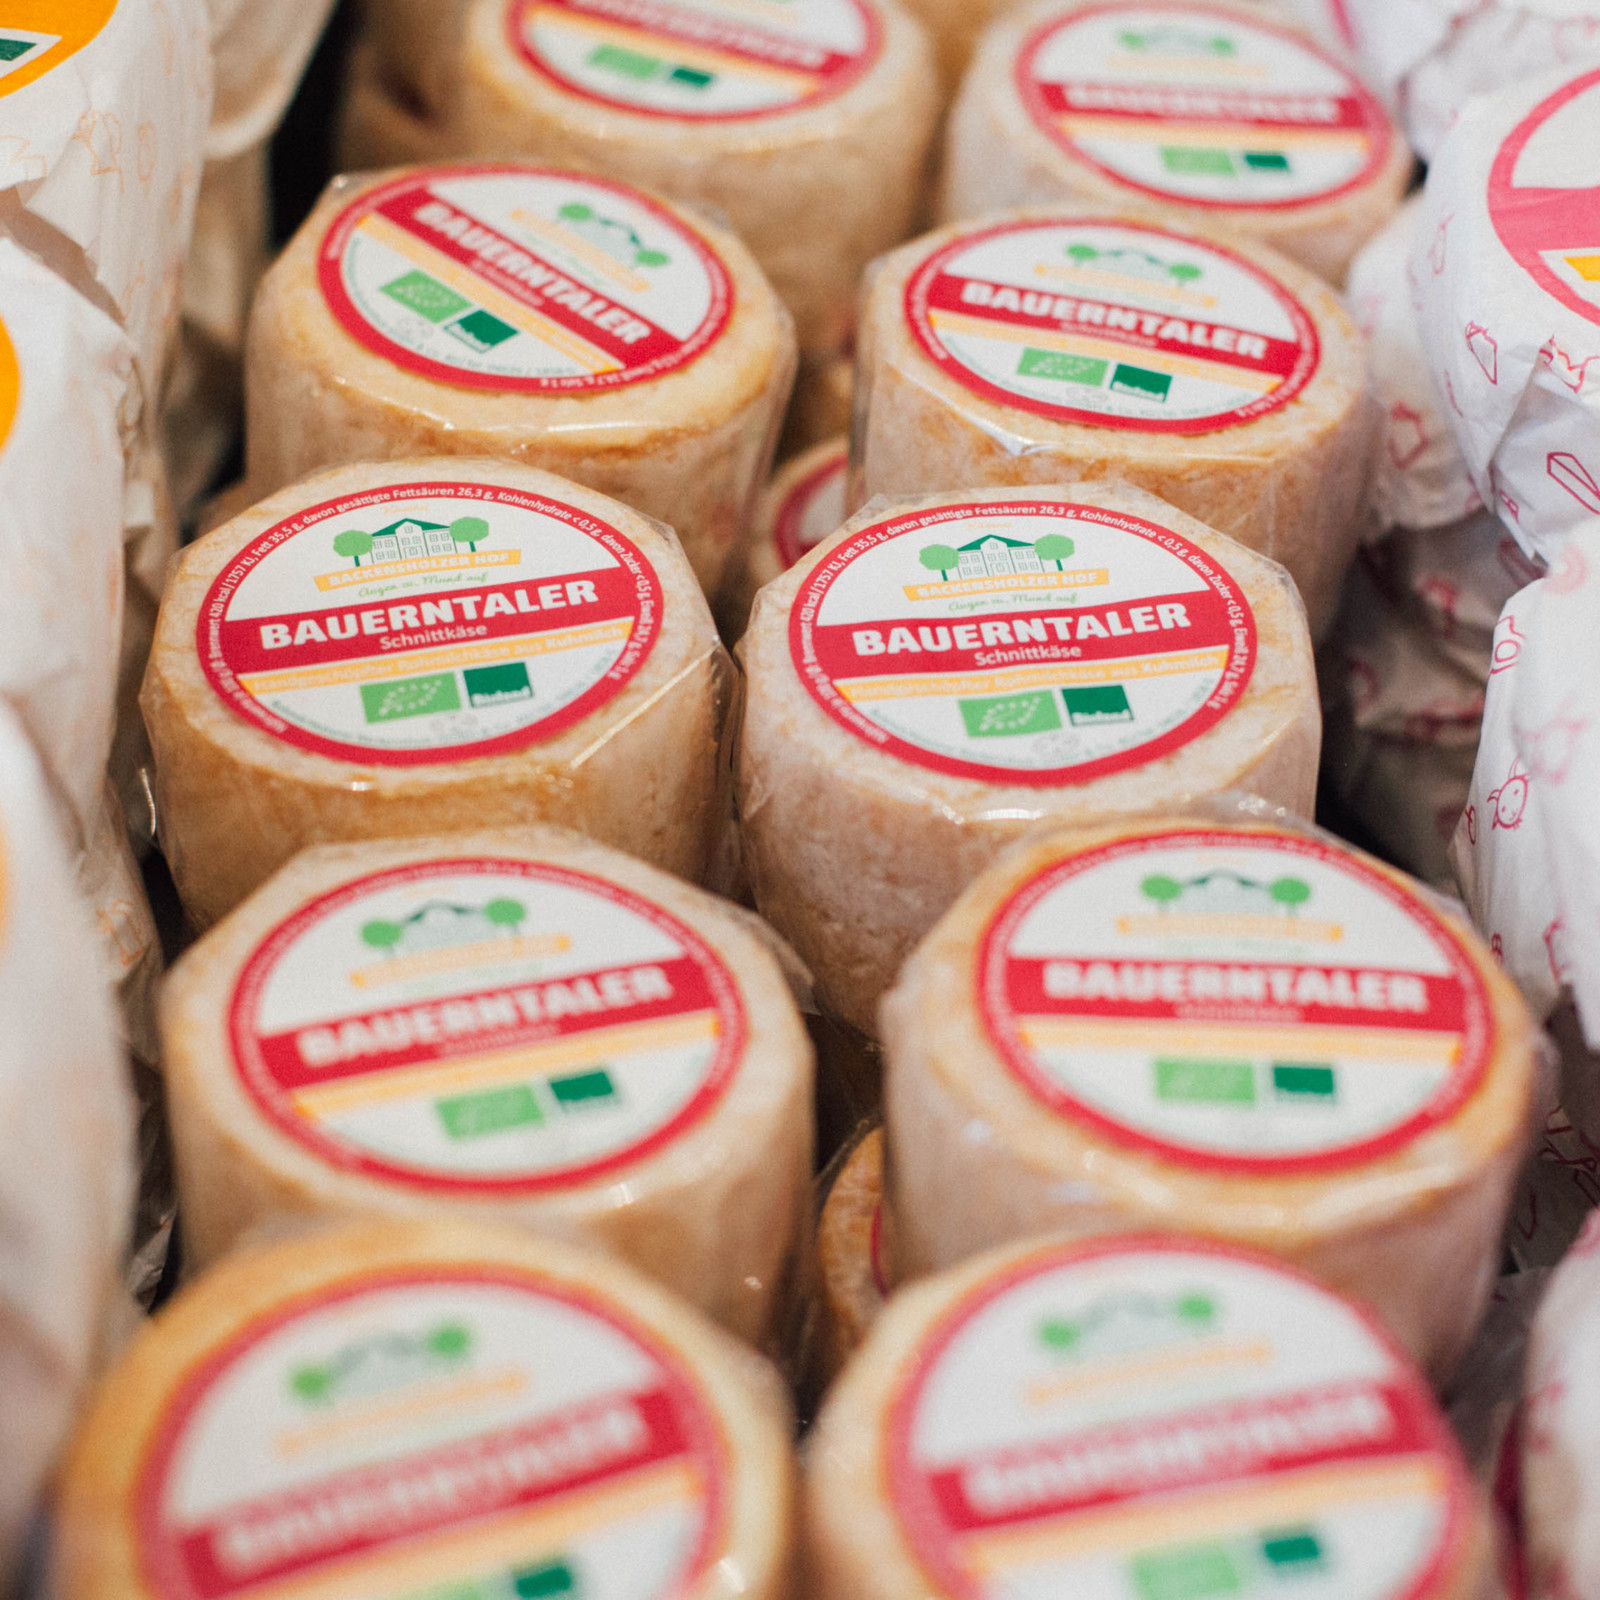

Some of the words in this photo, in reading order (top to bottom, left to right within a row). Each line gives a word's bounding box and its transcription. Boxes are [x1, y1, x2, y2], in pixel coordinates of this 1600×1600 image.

[412, 201, 652, 345] BAUERNTALER
[961, 281, 1268, 360] BAUERNTALER
[392, 487, 455, 499] Fettsäuren
[456, 487, 483, 498] 26,3
[336, 493, 390, 513] gesättigte
[496, 491, 573, 521] Kohlenhydrate
[974, 505, 1037, 515] Fettsäuren
[1038, 505, 1065, 516] 26,3
[302, 507, 336, 525] davon
[919, 509, 973, 527] gesättigte
[1079, 509, 1157, 539] Kohlenhydrate
[267, 526, 293, 544] 35,5
[886, 520, 920, 536] davon
[250, 540, 274, 557] Fett
[600, 534, 626, 554] davon
[853, 534, 878, 551] 35,5
[619, 551, 643, 575] Zucker
[837, 546, 860, 562] Fett
[225, 564, 247, 584] 1757
[327, 554, 471, 586] BACKENSHOLZER
[474, 552, 511, 565] HOF
[1187, 555, 1214, 577] davon
[813, 568, 834, 589] 1757
[1061, 572, 1098, 584] HOF
[1208, 574, 1233, 599] Zucker
[213, 586, 232, 603] kcal
[803, 591, 821, 608] kcal
[208, 602, 225, 618] 420
[259, 579, 599, 650] BAUERNTALER
[799, 606, 816, 622] 420
[379, 624, 488, 651] Schnittkäse
[852, 602, 1192, 656] BAUERNTALER
[974, 642, 1082, 668] Schnittkäse
[1042, 959, 1429, 1013] BAUERNTALER
[301, 965, 674, 1068] BAUERNTALER
